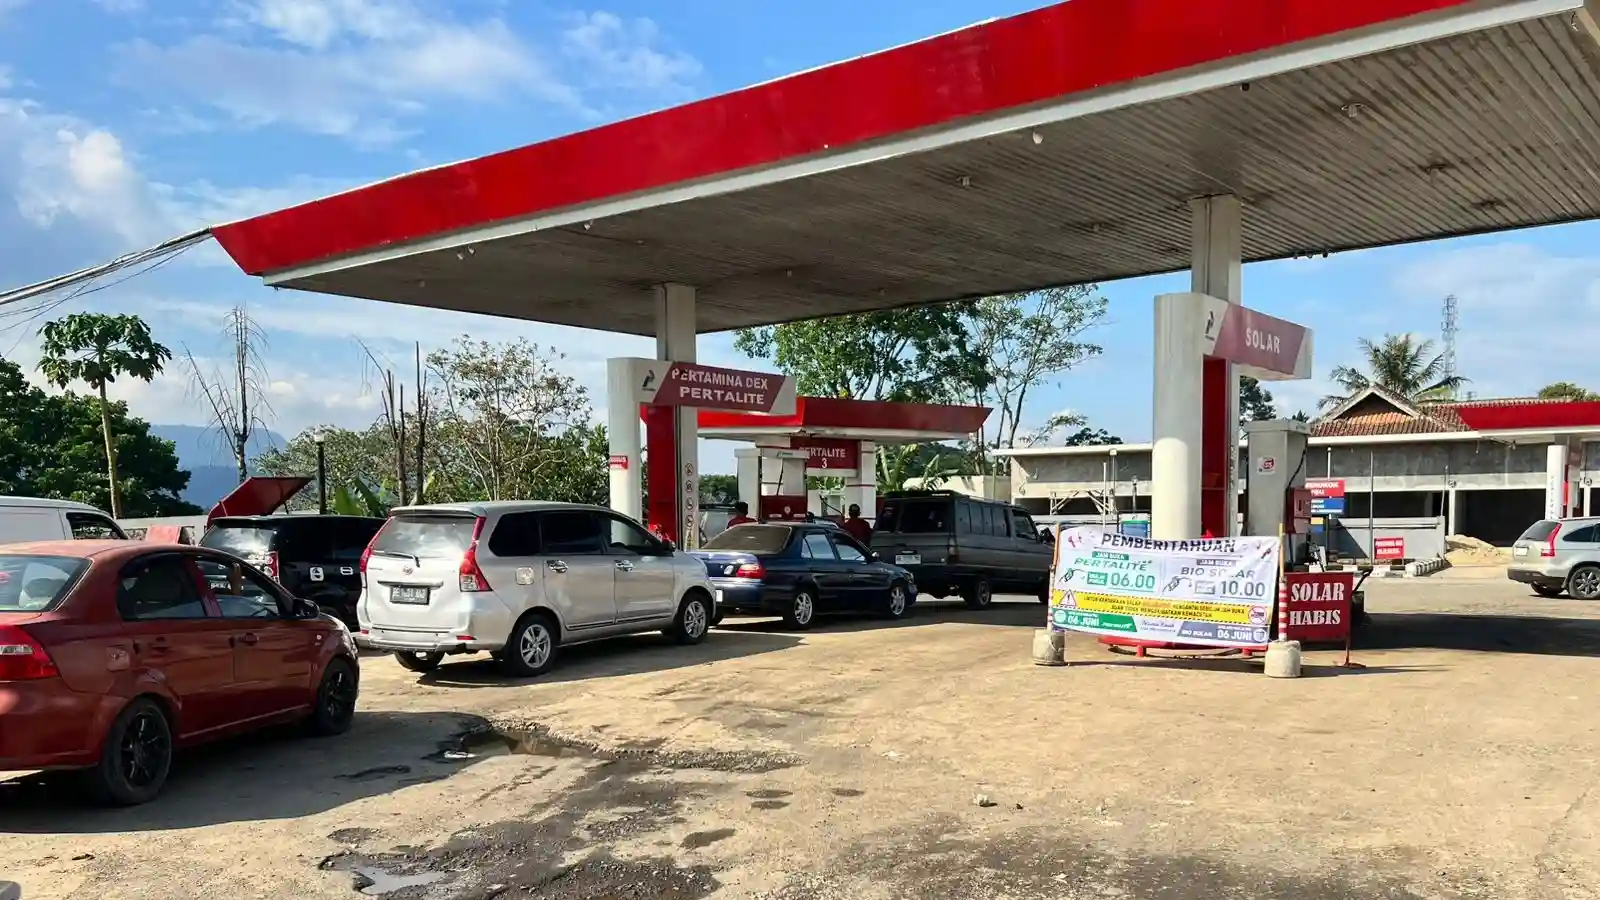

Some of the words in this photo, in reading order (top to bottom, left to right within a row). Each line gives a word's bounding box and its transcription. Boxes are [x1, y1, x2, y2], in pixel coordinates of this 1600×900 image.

[1245, 327, 1281, 354] SOLAR
[671, 368, 743, 388] PERTAMINA
[745, 377, 768, 390] DEX
[680, 386, 765, 405] PERTALITE
[800, 447, 846, 458] ERTALITE
[821, 457, 828, 469] 3
[1101, 533, 1236, 553] PEMBERITAHUAN
[1074, 557, 1149, 571] PERTALITE
[1110, 572, 1155, 589] 06.00
[1181, 567, 1205, 576] BIO
[1209, 568, 1256, 579] SOAR
[1221, 580, 1266, 597] 10.00
[1291, 582, 1345, 601] SOLAR
[1080, 616, 1100, 627] JUNI
[1289, 609, 1341, 626] HABIS
[1217, 629, 1229, 639] 06
[1230, 630, 1253, 641] JUNI
